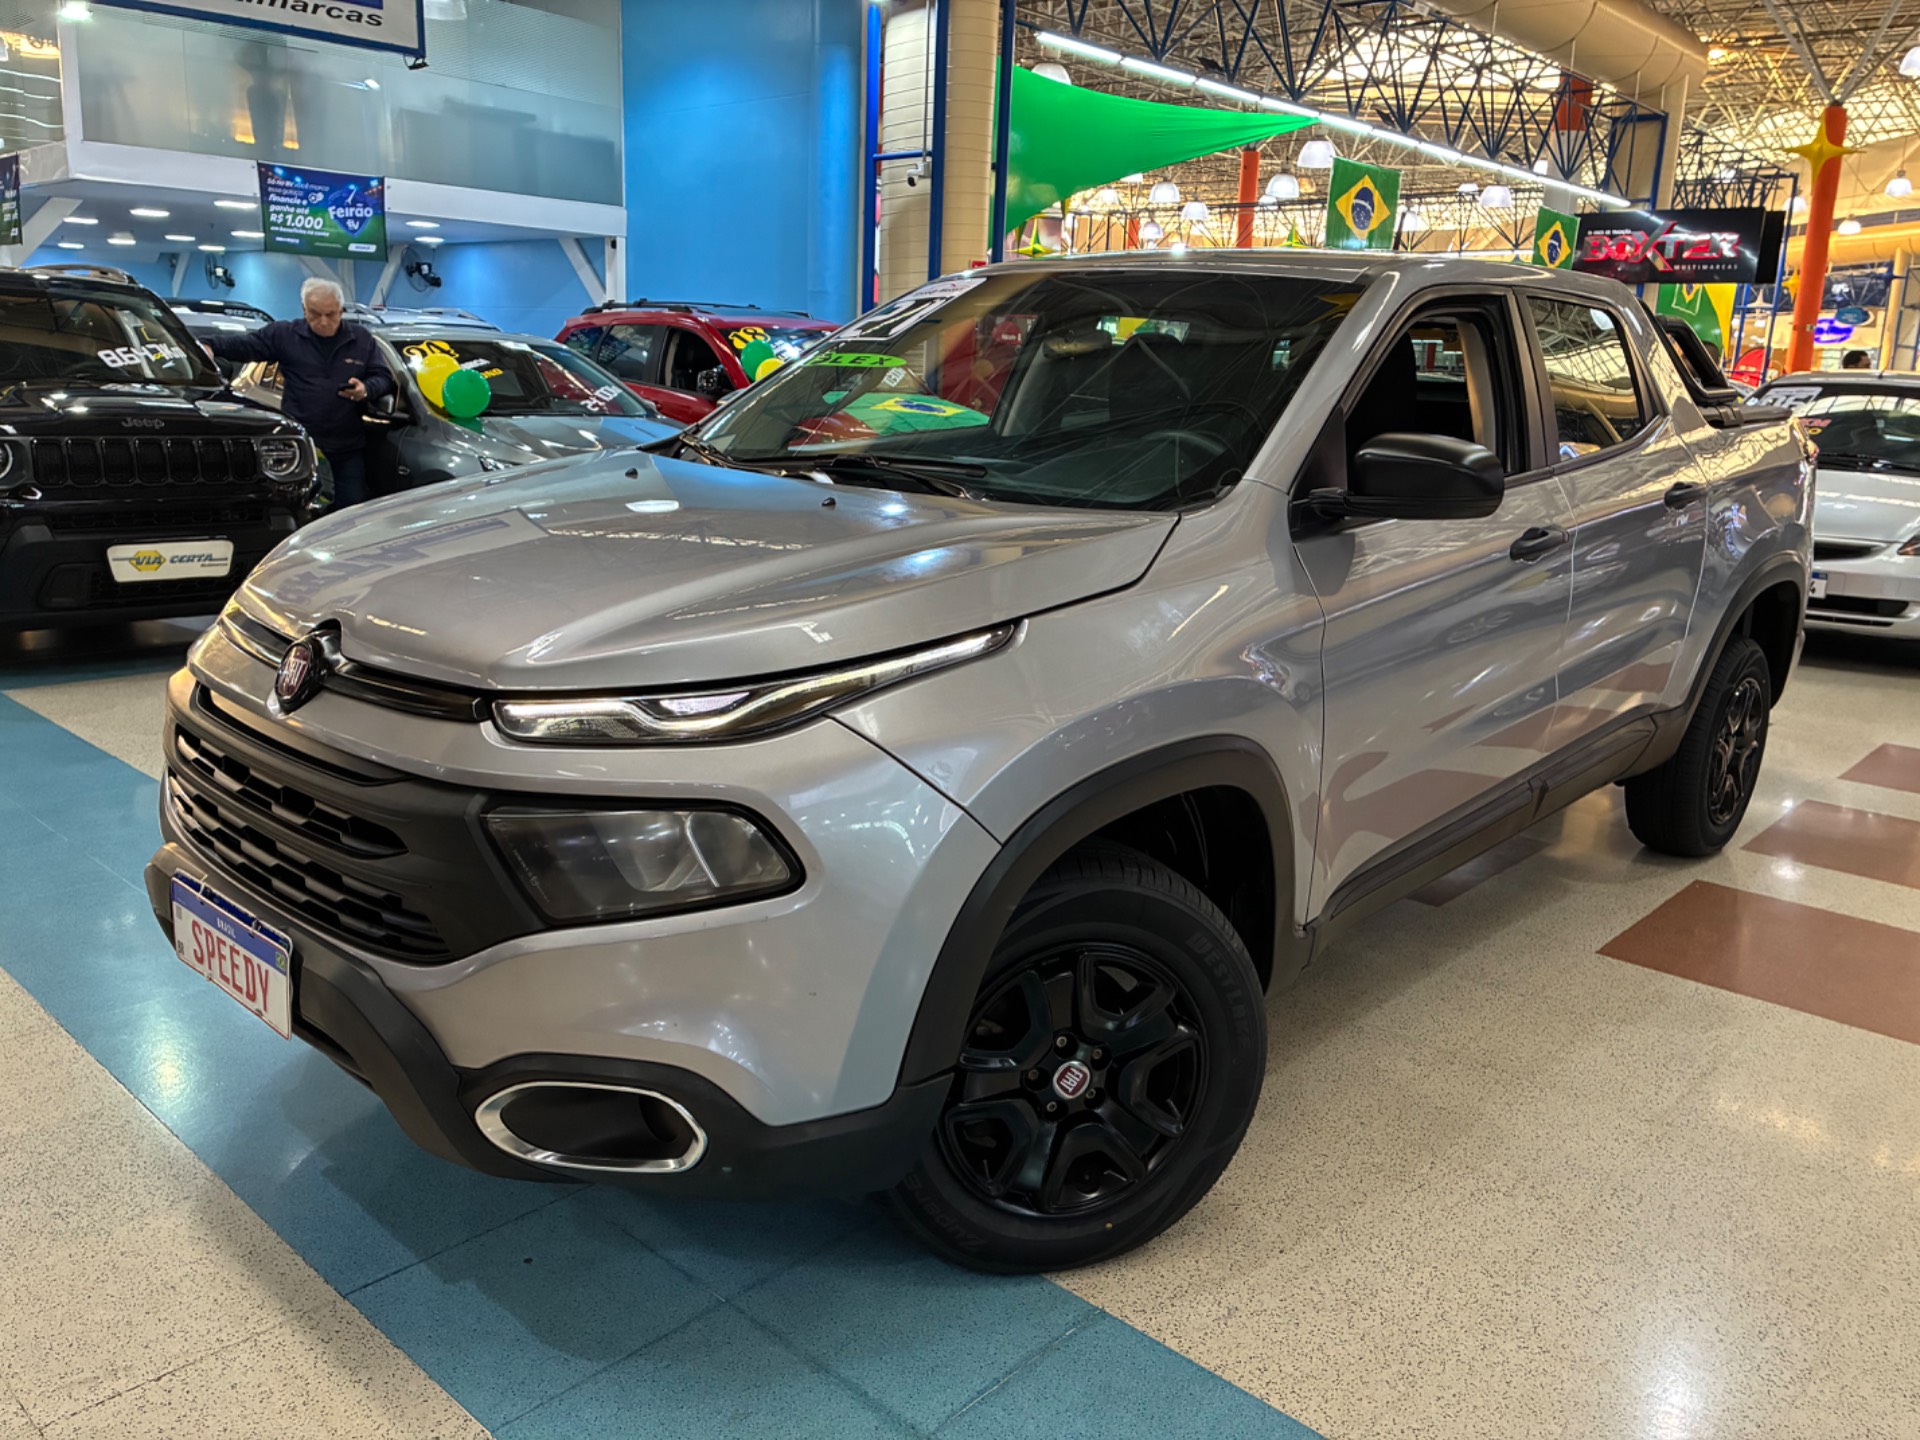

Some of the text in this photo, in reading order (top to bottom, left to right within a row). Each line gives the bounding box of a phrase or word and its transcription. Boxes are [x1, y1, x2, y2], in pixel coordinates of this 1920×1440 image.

[270, 204, 295, 213] ganhe
[328, 203, 373, 219] Feirão
[270, 213, 323, 229] R$ 1.000
[1583, 220, 1740, 272] BOXTER
[120, 416, 165, 429] Jeep
[134, 553, 213, 566] VIA CERTA
[191, 919, 269, 1013] SPEEDY
[1059, 1066, 1084, 1094] FIAT
